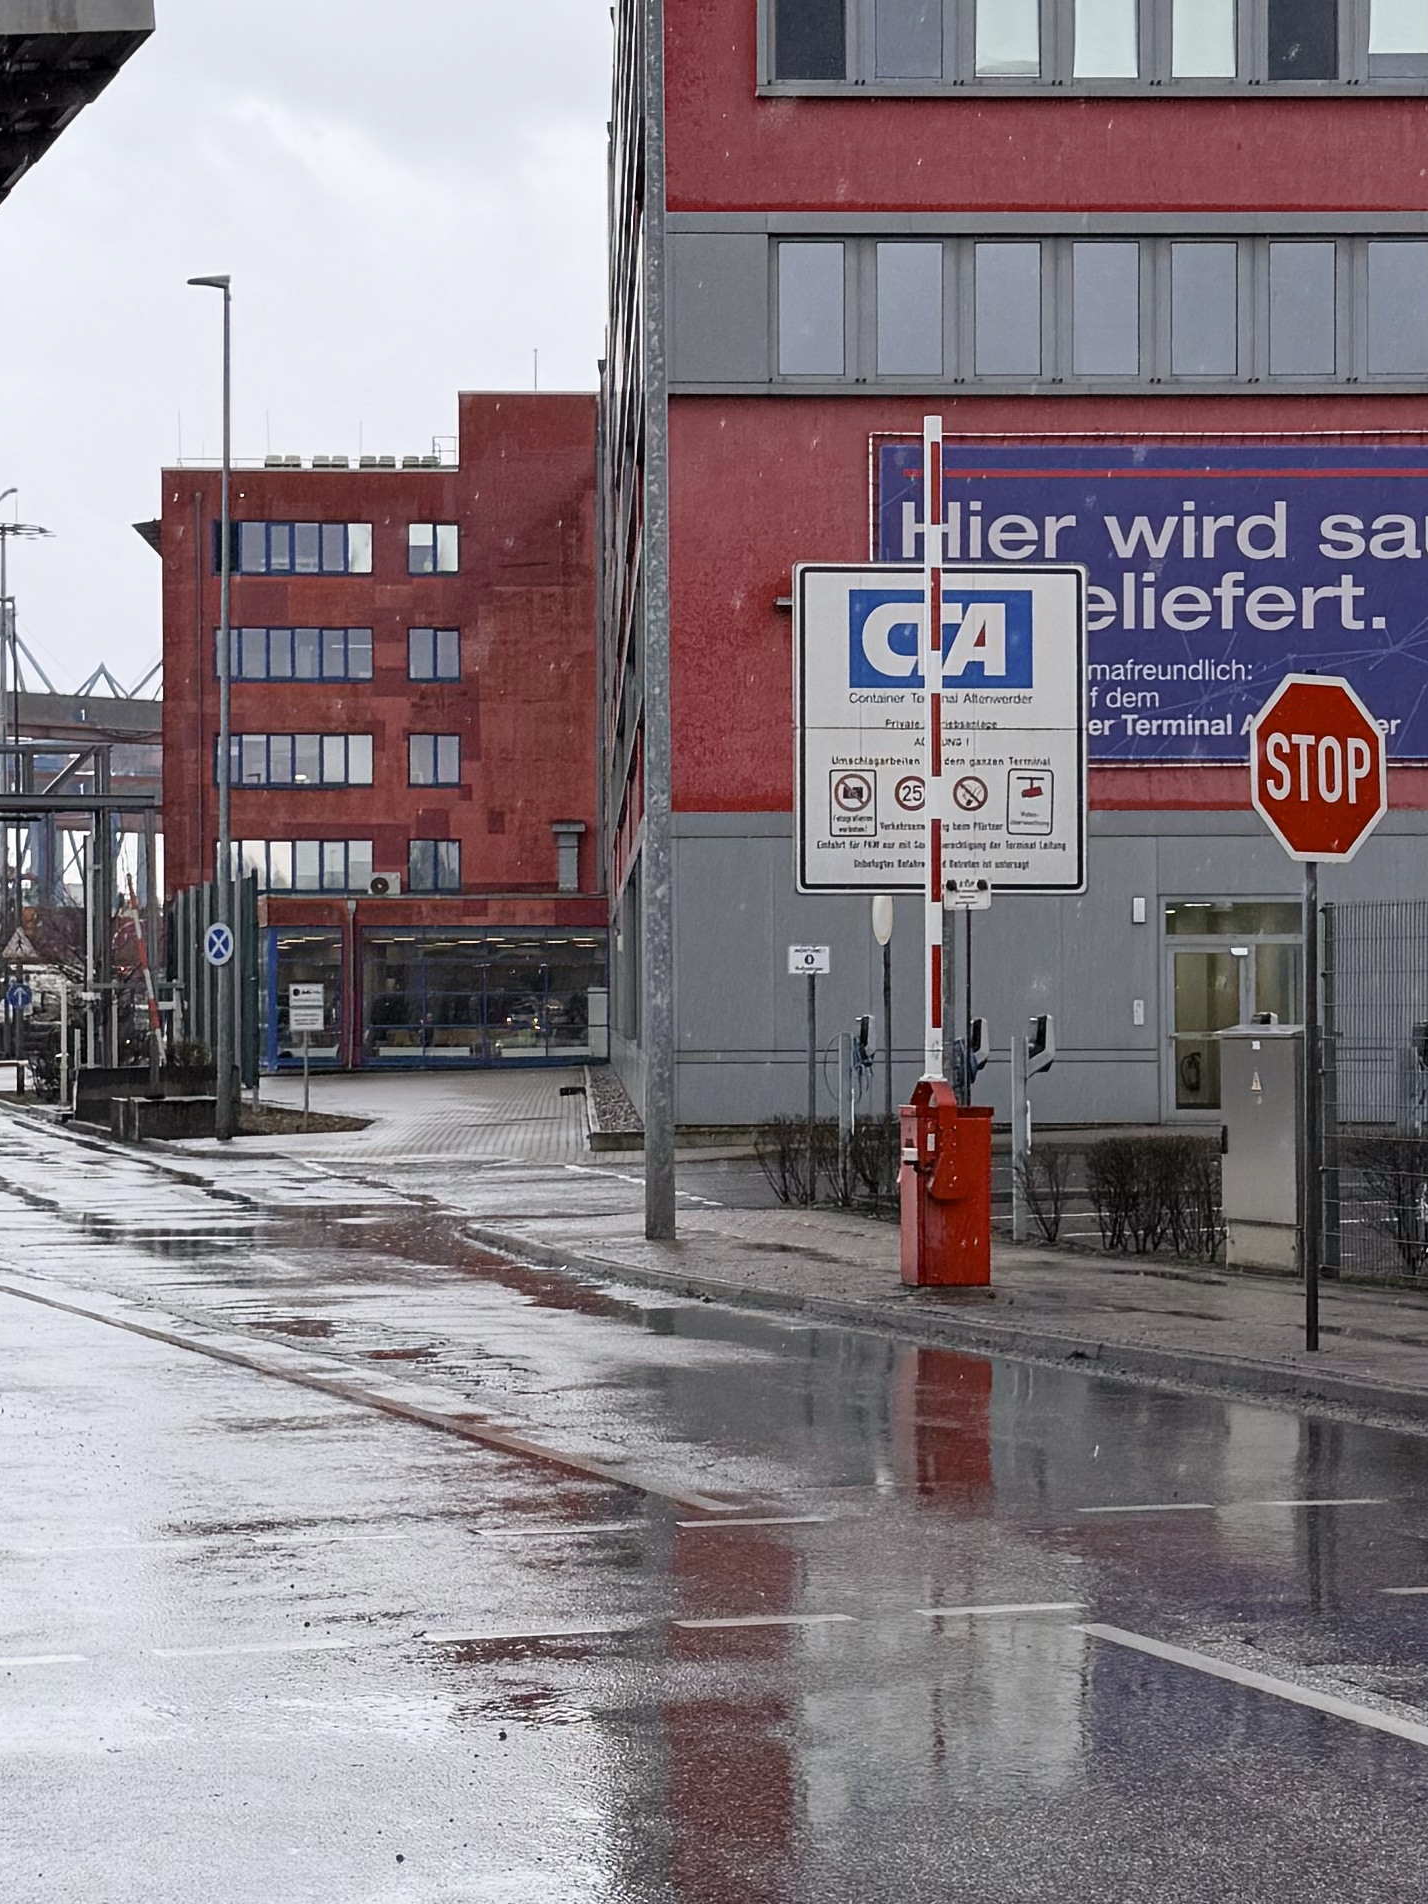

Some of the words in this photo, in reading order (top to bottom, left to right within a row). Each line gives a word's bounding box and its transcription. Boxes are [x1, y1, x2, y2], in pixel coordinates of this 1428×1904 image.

[901, 500, 1077, 560] Hier
[1104, 500, 1287, 559] wird
[1087, 571, 1387, 631] eliefert.
[1087, 659, 1253, 681] mafreundlich:
[849, 692, 905, 704] Container
[910, 692, 958, 704] Tenal
[963, 692, 1033, 704] Altenwerder
[1105, 687, 1159, 708] dem
[885, 719, 921, 728] Private
[1122, 714, 1233, 736] Terminal
[831, 756, 921, 767] Umschlagarbeiten
[969, 758, 1005, 768] ganzen
[1008, 756, 1051, 766] Terminal
[1265, 731, 1371, 805] STOP
[902, 785, 922, 802] 25
